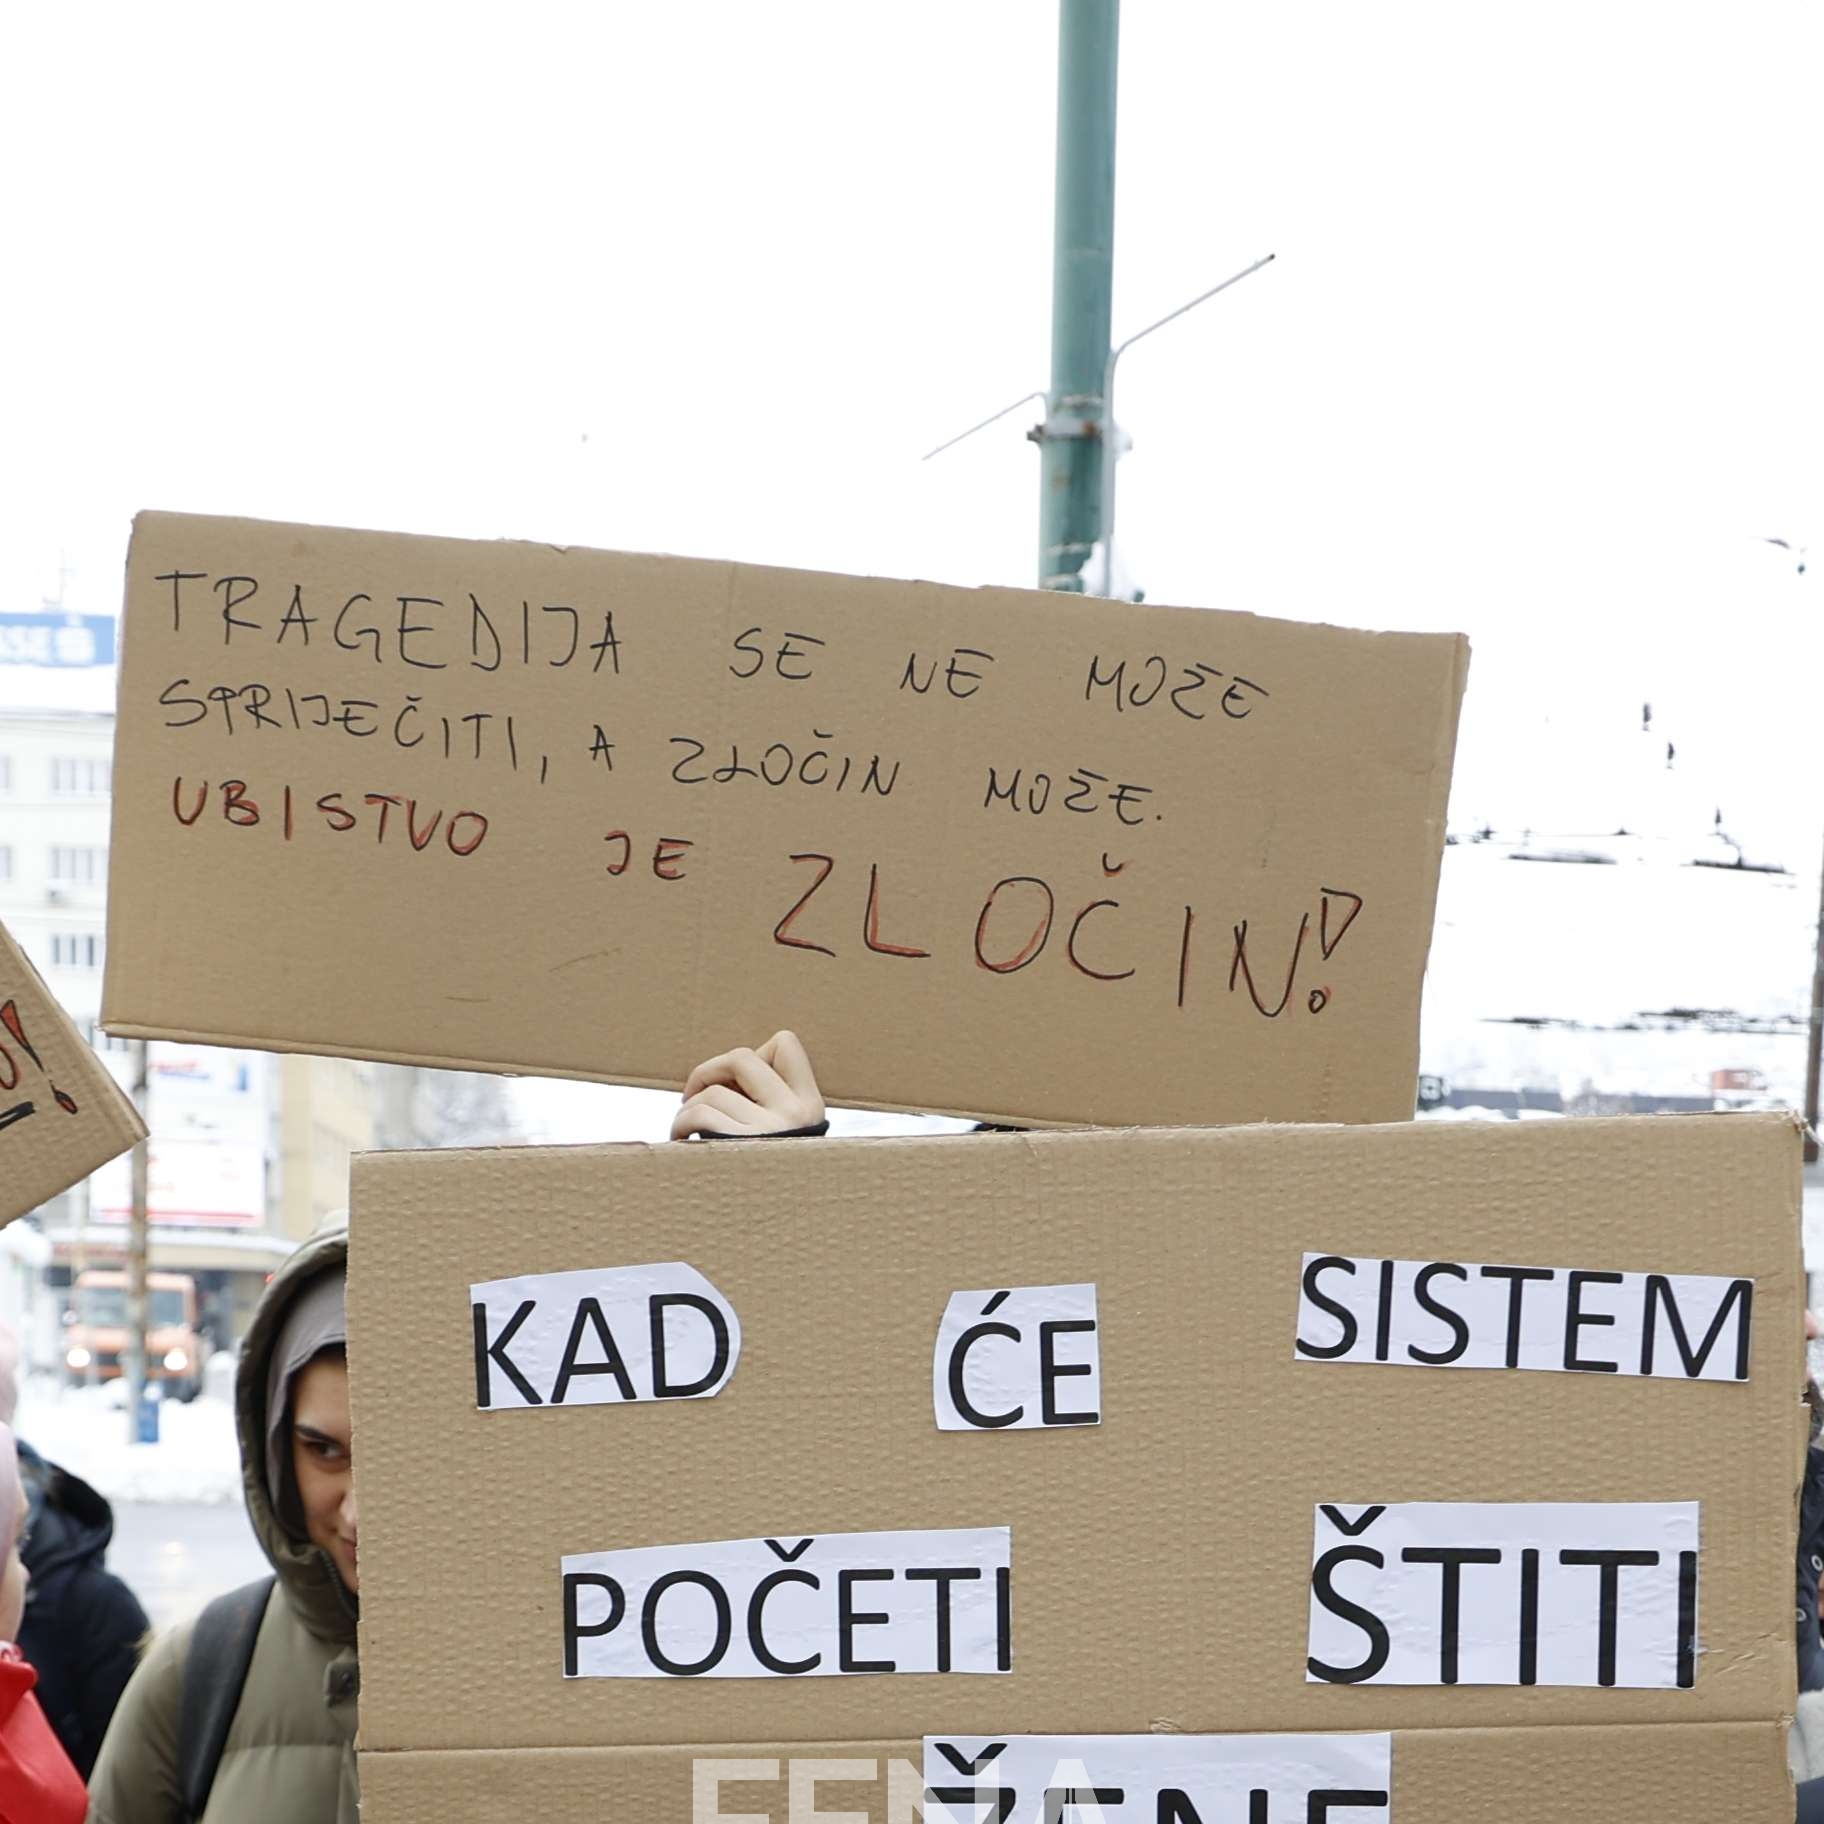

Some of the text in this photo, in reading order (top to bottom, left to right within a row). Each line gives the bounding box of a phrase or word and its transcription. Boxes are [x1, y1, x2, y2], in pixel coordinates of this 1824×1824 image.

[155, 568, 623, 674] TRAGEDIJA
[728, 626, 826, 680] SE
[900, 648, 995, 699] NE
[158, 678, 548, 785] SPRIJEČITI,
[588, 723, 616, 772] A
[669, 729, 899, 797] ZLOČIN
[171, 776, 1363, 1019] UBISTVO JE ZLOČIN!
[471, 1255, 1754, 1429] KAD ĆE SISTEM
[562, 1503, 1698, 1689] POČETI ŠTITI
